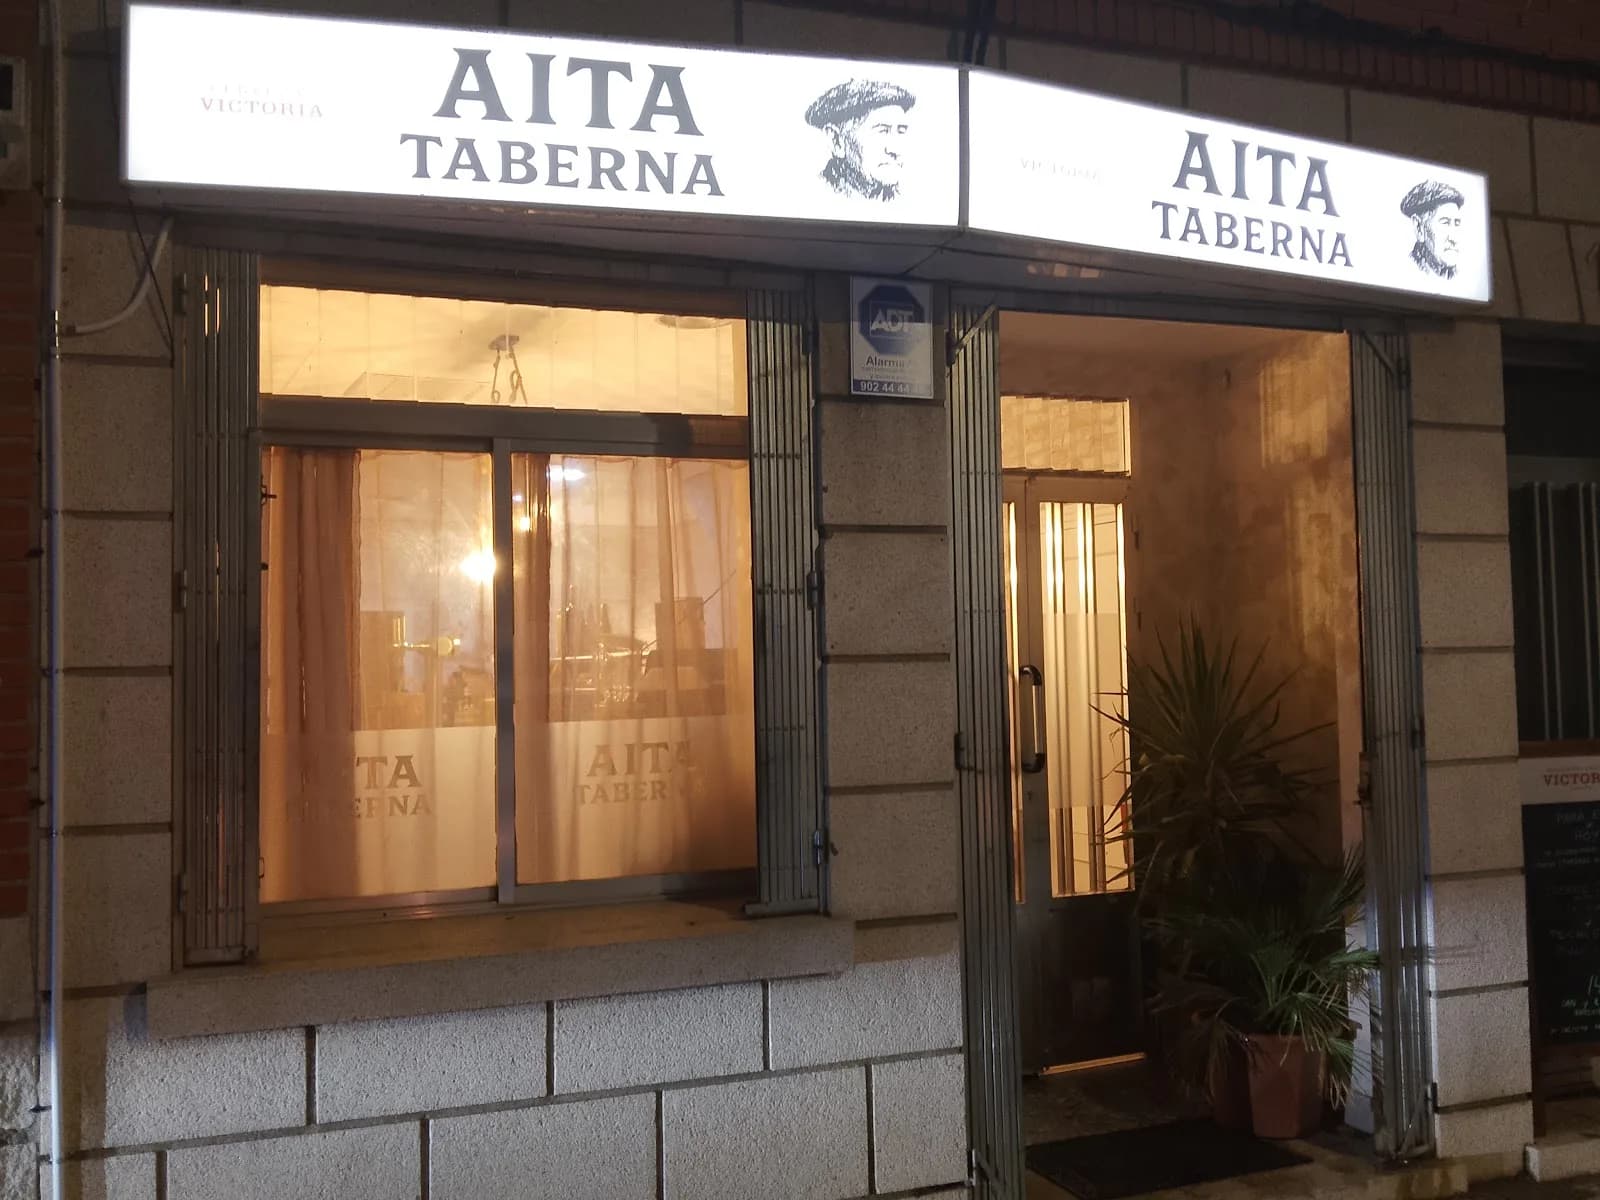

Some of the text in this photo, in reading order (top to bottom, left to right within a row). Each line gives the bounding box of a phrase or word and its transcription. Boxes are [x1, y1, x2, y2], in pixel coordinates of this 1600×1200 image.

[199, 96, 323, 119] VICTORIA
[432, 47, 705, 137] AITA
[400, 133, 725, 197] TABERNA
[1172, 129, 1341, 218] AITA
[1151, 199, 1355, 269] TABERNA
[870, 307, 914, 333] ADT
[860, 381, 879, 393] 902
[882, 382, 895, 393] 44
